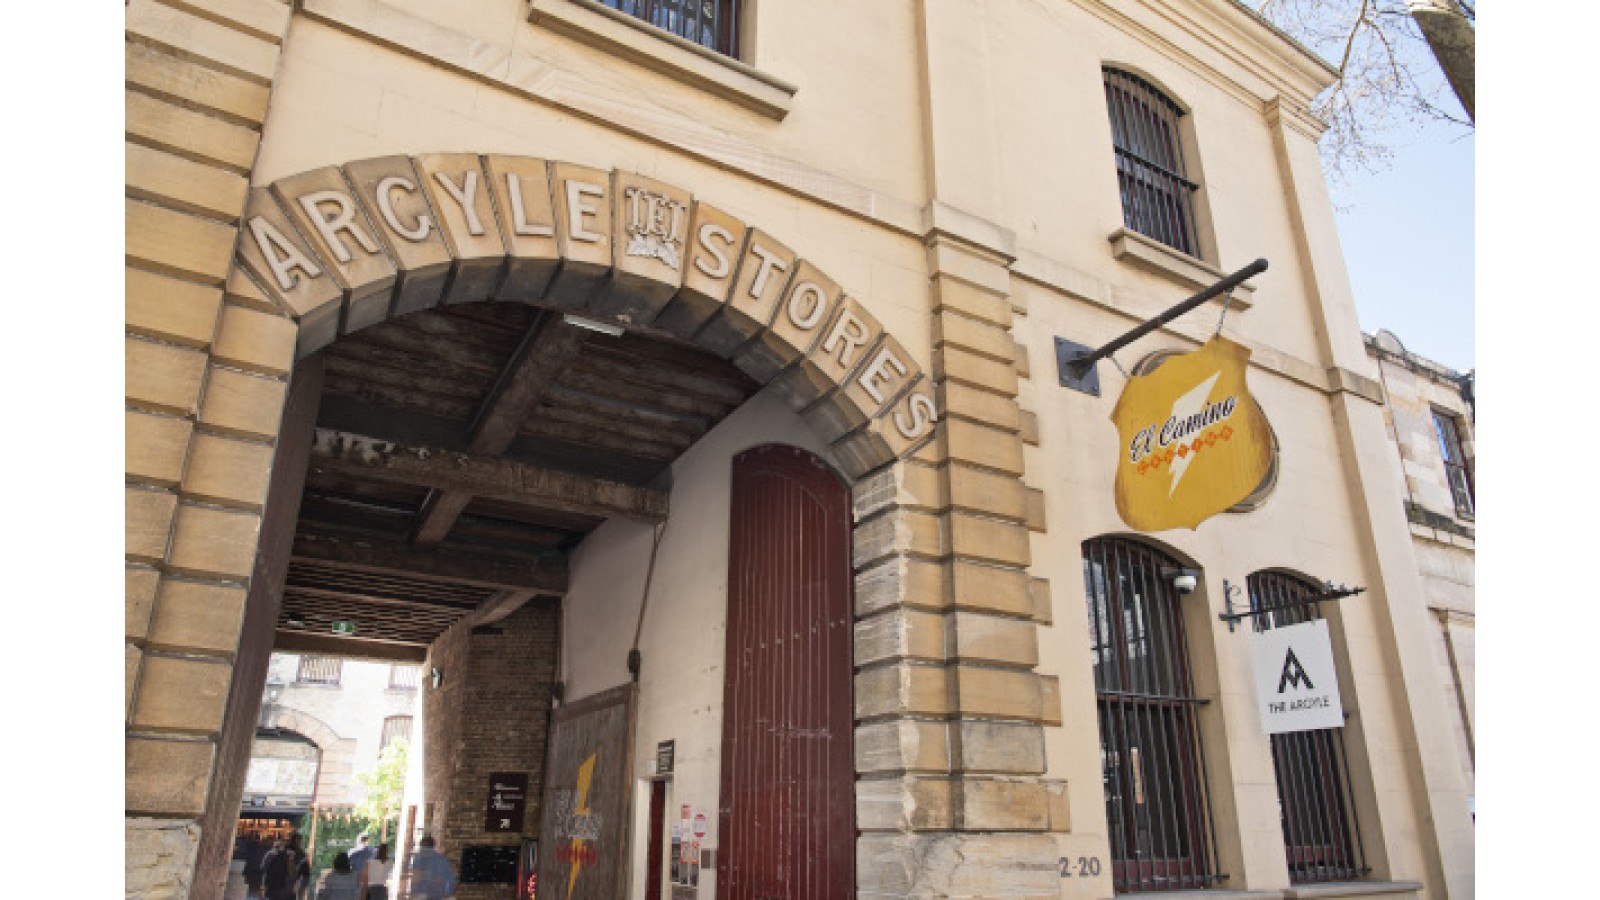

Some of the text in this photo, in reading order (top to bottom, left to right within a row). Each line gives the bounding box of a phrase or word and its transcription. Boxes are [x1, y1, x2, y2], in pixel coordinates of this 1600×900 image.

[694, 223, 938, 439] STORES
[1130, 423, 1157, 464] El
[1159, 396, 1239, 448] Camino
[1268, 695, 1330, 714] THE ARGYLE
